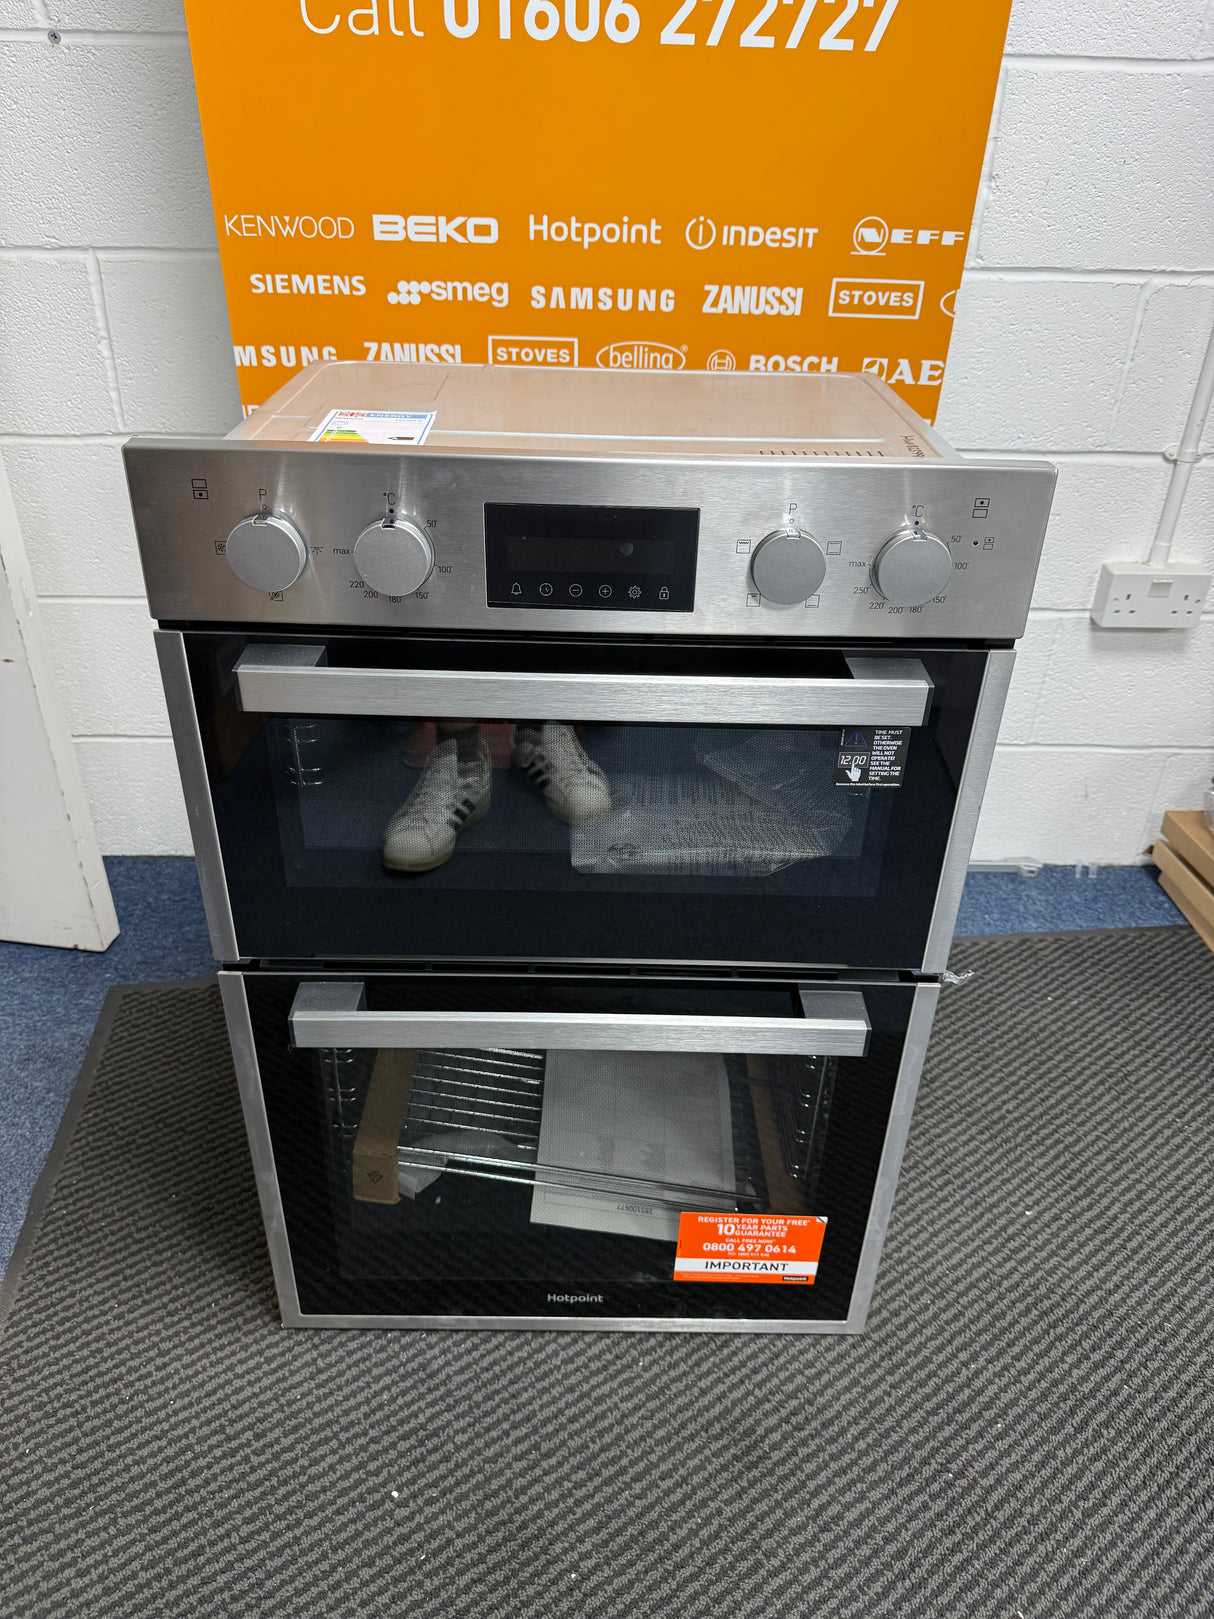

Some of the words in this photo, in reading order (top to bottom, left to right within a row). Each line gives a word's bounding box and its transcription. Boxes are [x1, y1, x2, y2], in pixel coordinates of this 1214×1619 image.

[299, 0, 425, 37] Call
[443, 0, 641, 44] 01606
[659, 0, 901, 52] 272727
[224, 214, 355, 239] KENWOOD
[371, 214, 499, 244] BEKO
[529, 214, 662, 250] Hotpoint
[855, 219, 965, 250] NEFF
[249, 273, 367, 296] SIEMENS
[431, 280, 510, 308] smeg
[530, 285, 675, 313] SAMSUNG
[702, 284, 804, 316] ZANUSSI
[838, 289, 914, 307] STOVES
[363, 341, 462, 363] ZANUSSI
[496, 346, 571, 363] STOVES
[748, 354, 839, 373] BOSCH
[258, 488, 268, 502] P
[788, 502, 798, 515] P
[333, 547, 351, 556] max
[840, 755, 867, 765] 12.00
[698, 1216, 740, 1224] REGISTER
[741, 1217, 759, 1225] FOR
[760, 1218, 785, 1226] YOUR
[717, 1223, 736, 1236] 10
[736, 1223, 759, 1231] YEAR
[760, 1224, 788, 1232] PARTS
[734, 1230, 786, 1238] GUARANTEE
[702, 1242, 735, 1252] 0800
[737, 1243, 762, 1253] 497
[764, 1244, 797, 1255] 0614
[704, 1260, 790, 1272] IMPORTANT
[546, 1293, 604, 1304] Hotpoint
